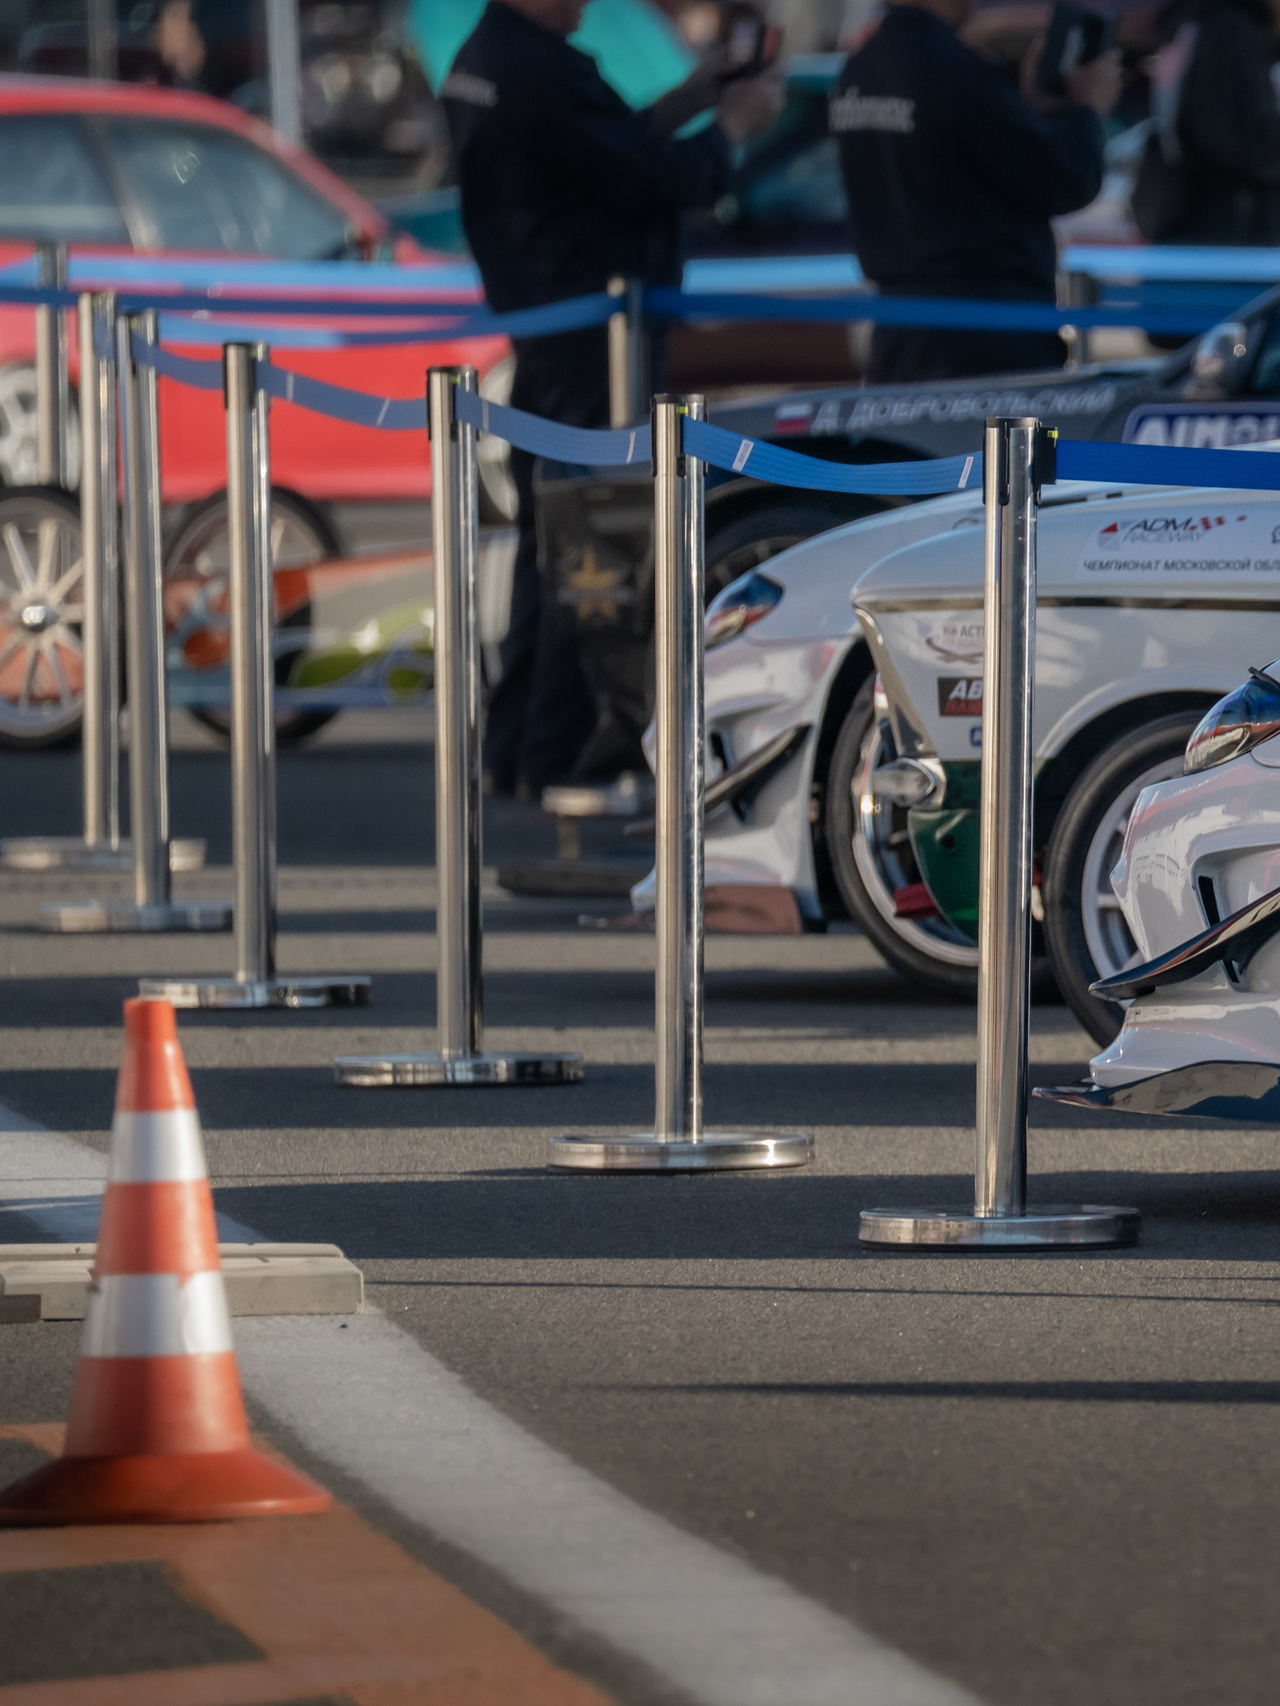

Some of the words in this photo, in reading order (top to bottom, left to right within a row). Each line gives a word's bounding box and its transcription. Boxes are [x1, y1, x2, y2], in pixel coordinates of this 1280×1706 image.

[1129, 517, 1193, 531] ADM
[1083, 559, 1160, 572] ЧЕМПИОНАТ
[1163, 558, 1250, 572] МОСКОВСКОЙ
